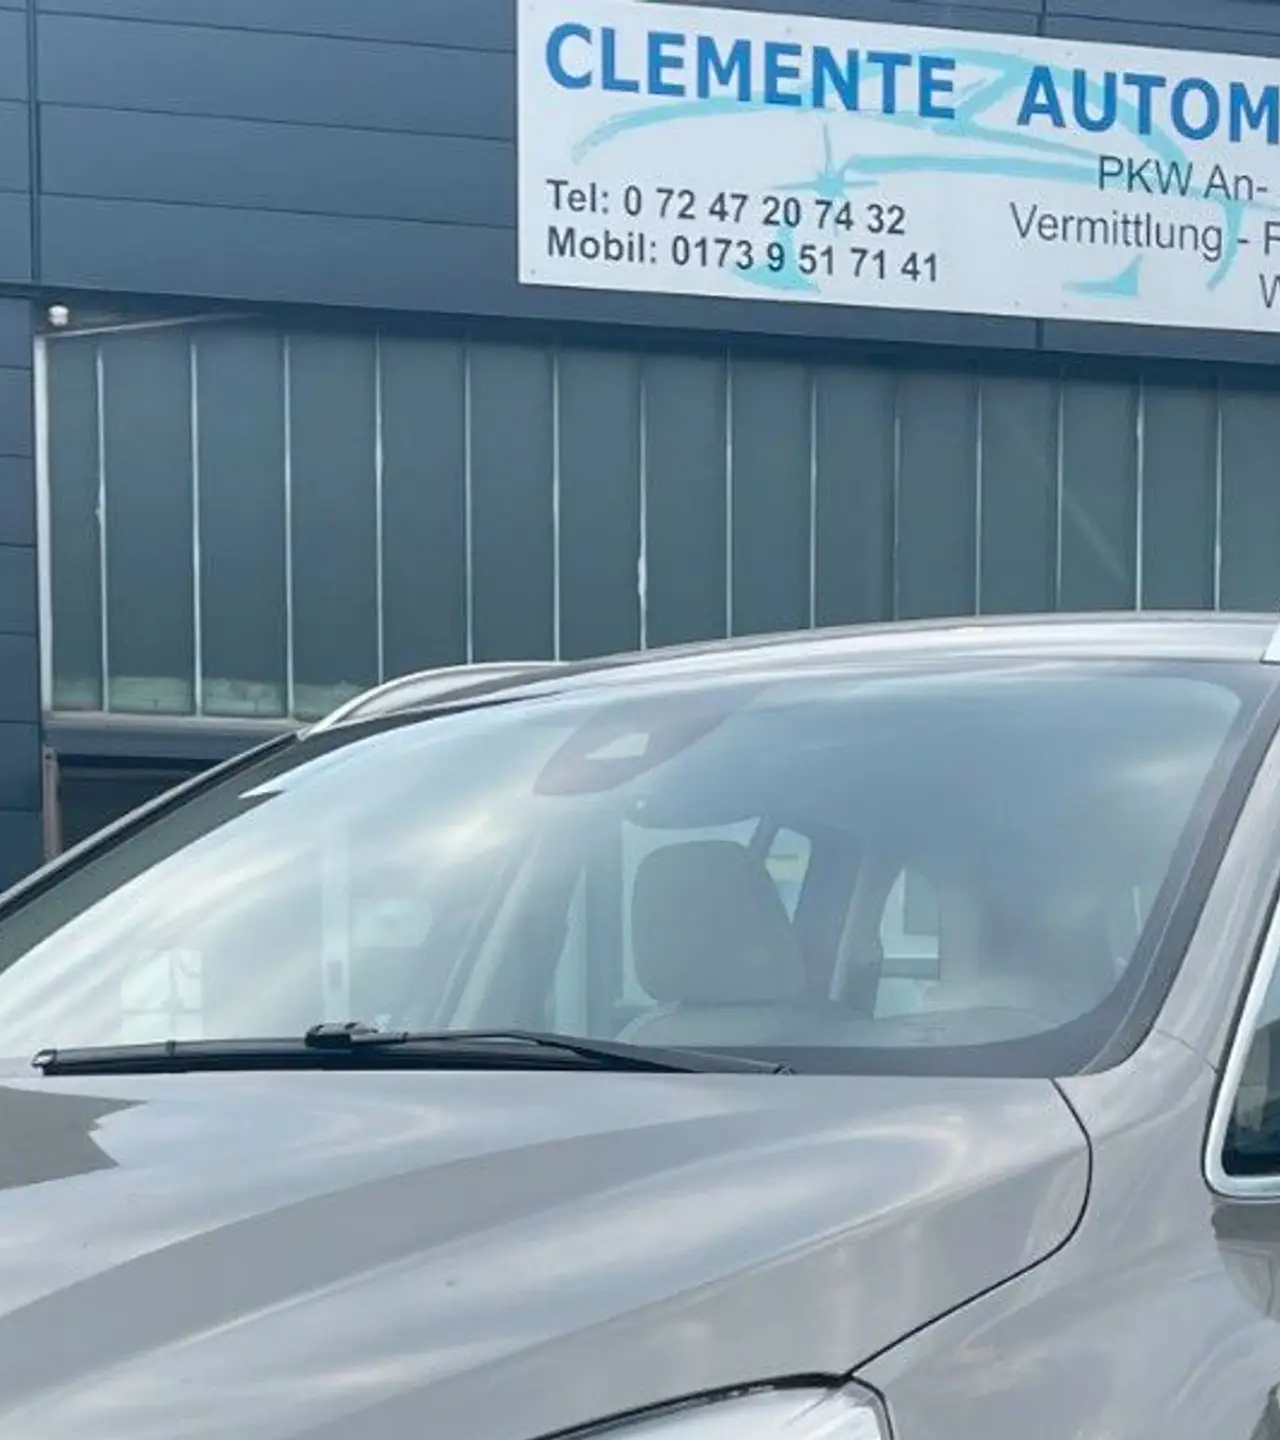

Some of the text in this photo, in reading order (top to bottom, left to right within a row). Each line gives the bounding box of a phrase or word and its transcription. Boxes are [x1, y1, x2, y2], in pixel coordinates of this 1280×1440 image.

[545, 22, 957, 120] CLEMENTE
[1098, 155, 1194, 196] PKW
[1204, 164, 1268, 201] An-
[546, 180, 906, 236] Tel: 0 72 47 20 74 32
[1010, 202, 1222, 261] Vermittlung
[547, 226, 938, 282] Mobil: 0173 9 51 71 41
